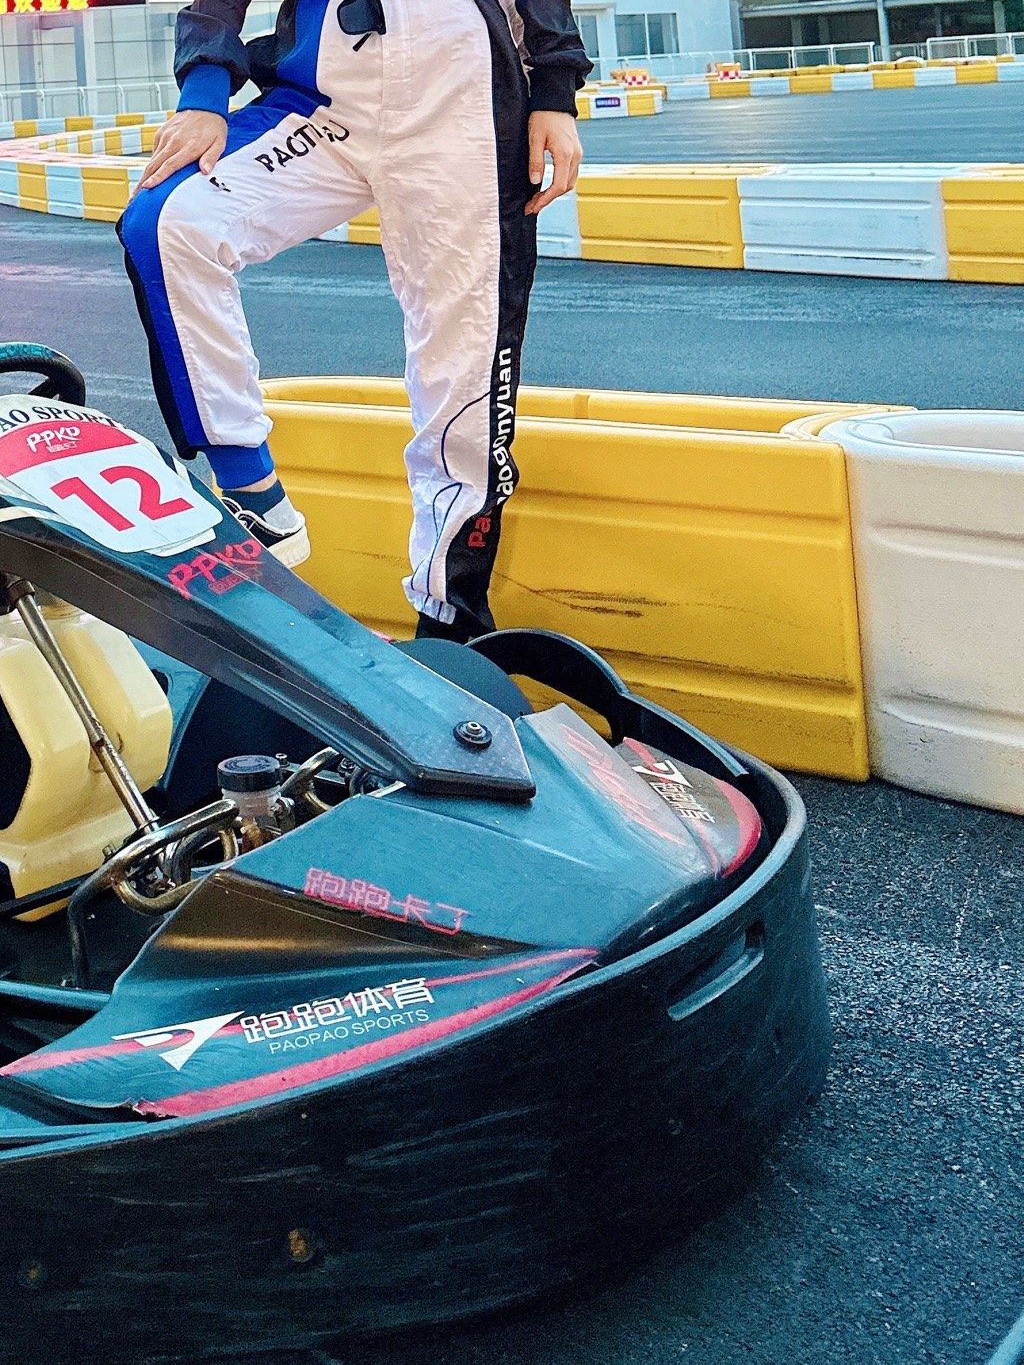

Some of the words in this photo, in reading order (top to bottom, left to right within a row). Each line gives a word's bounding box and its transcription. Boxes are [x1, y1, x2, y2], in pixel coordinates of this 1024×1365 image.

[50, 465, 194, 532] 12
[239, 977, 436, 1044] 跑跑体育
[268, 1026, 350, 1055] PAOPAO
[352, 1009, 430, 1036] SPORTS
